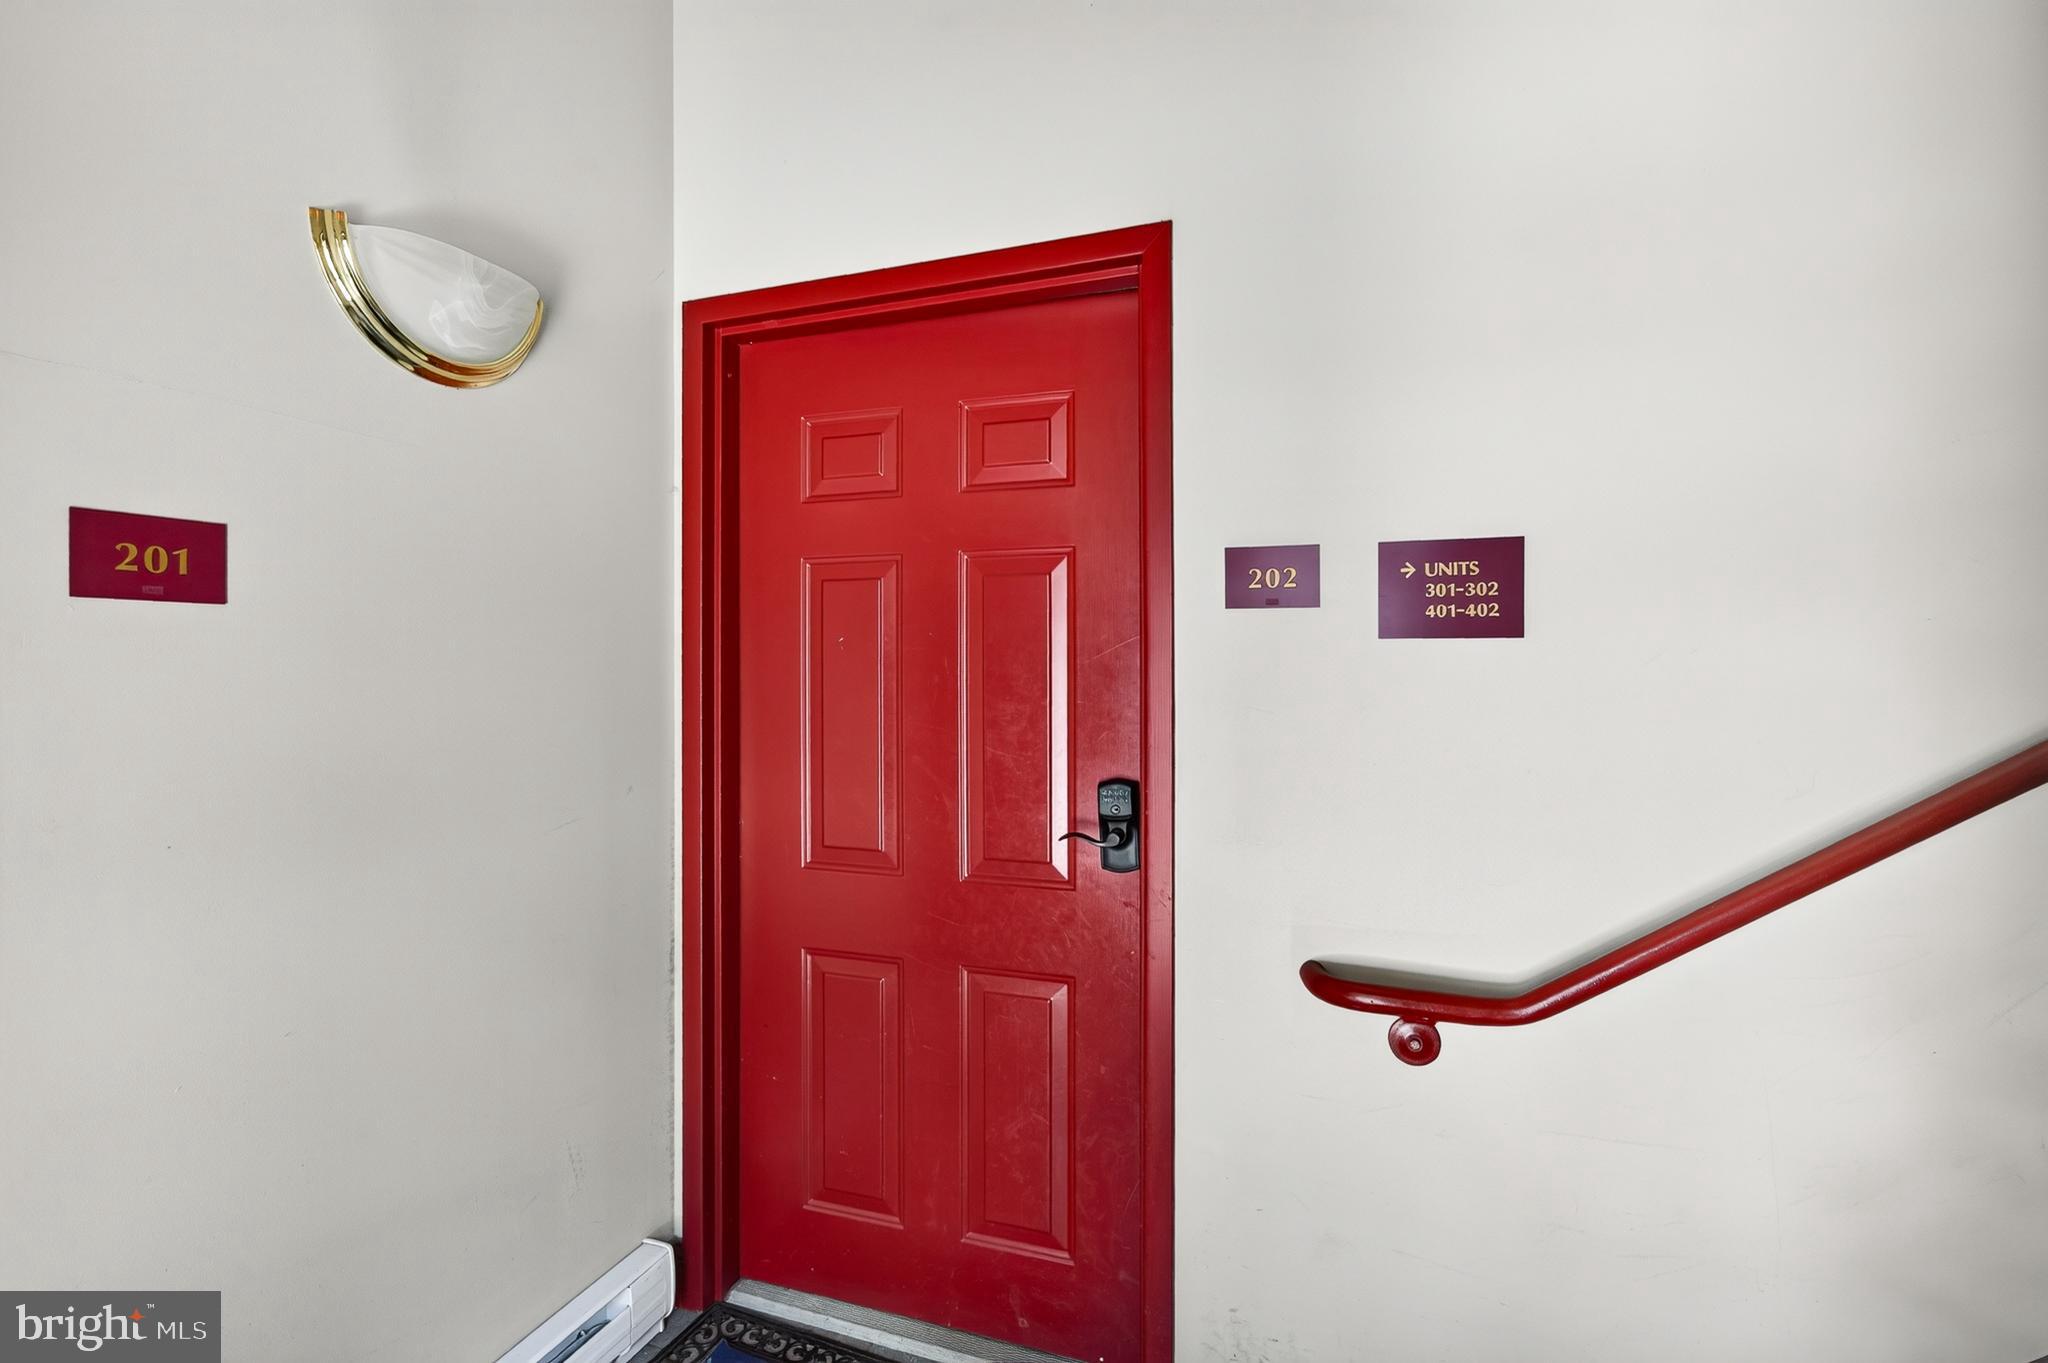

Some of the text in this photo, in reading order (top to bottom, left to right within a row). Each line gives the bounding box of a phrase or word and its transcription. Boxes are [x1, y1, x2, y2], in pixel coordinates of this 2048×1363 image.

[114, 542, 189, 576] 201
[1424, 560, 1480, 577] UNITS
[1248, 567, 1298, 589] 202
[1424, 581, 1499, 598] 301-302
[1424, 603, 1500, 618] 401-402
